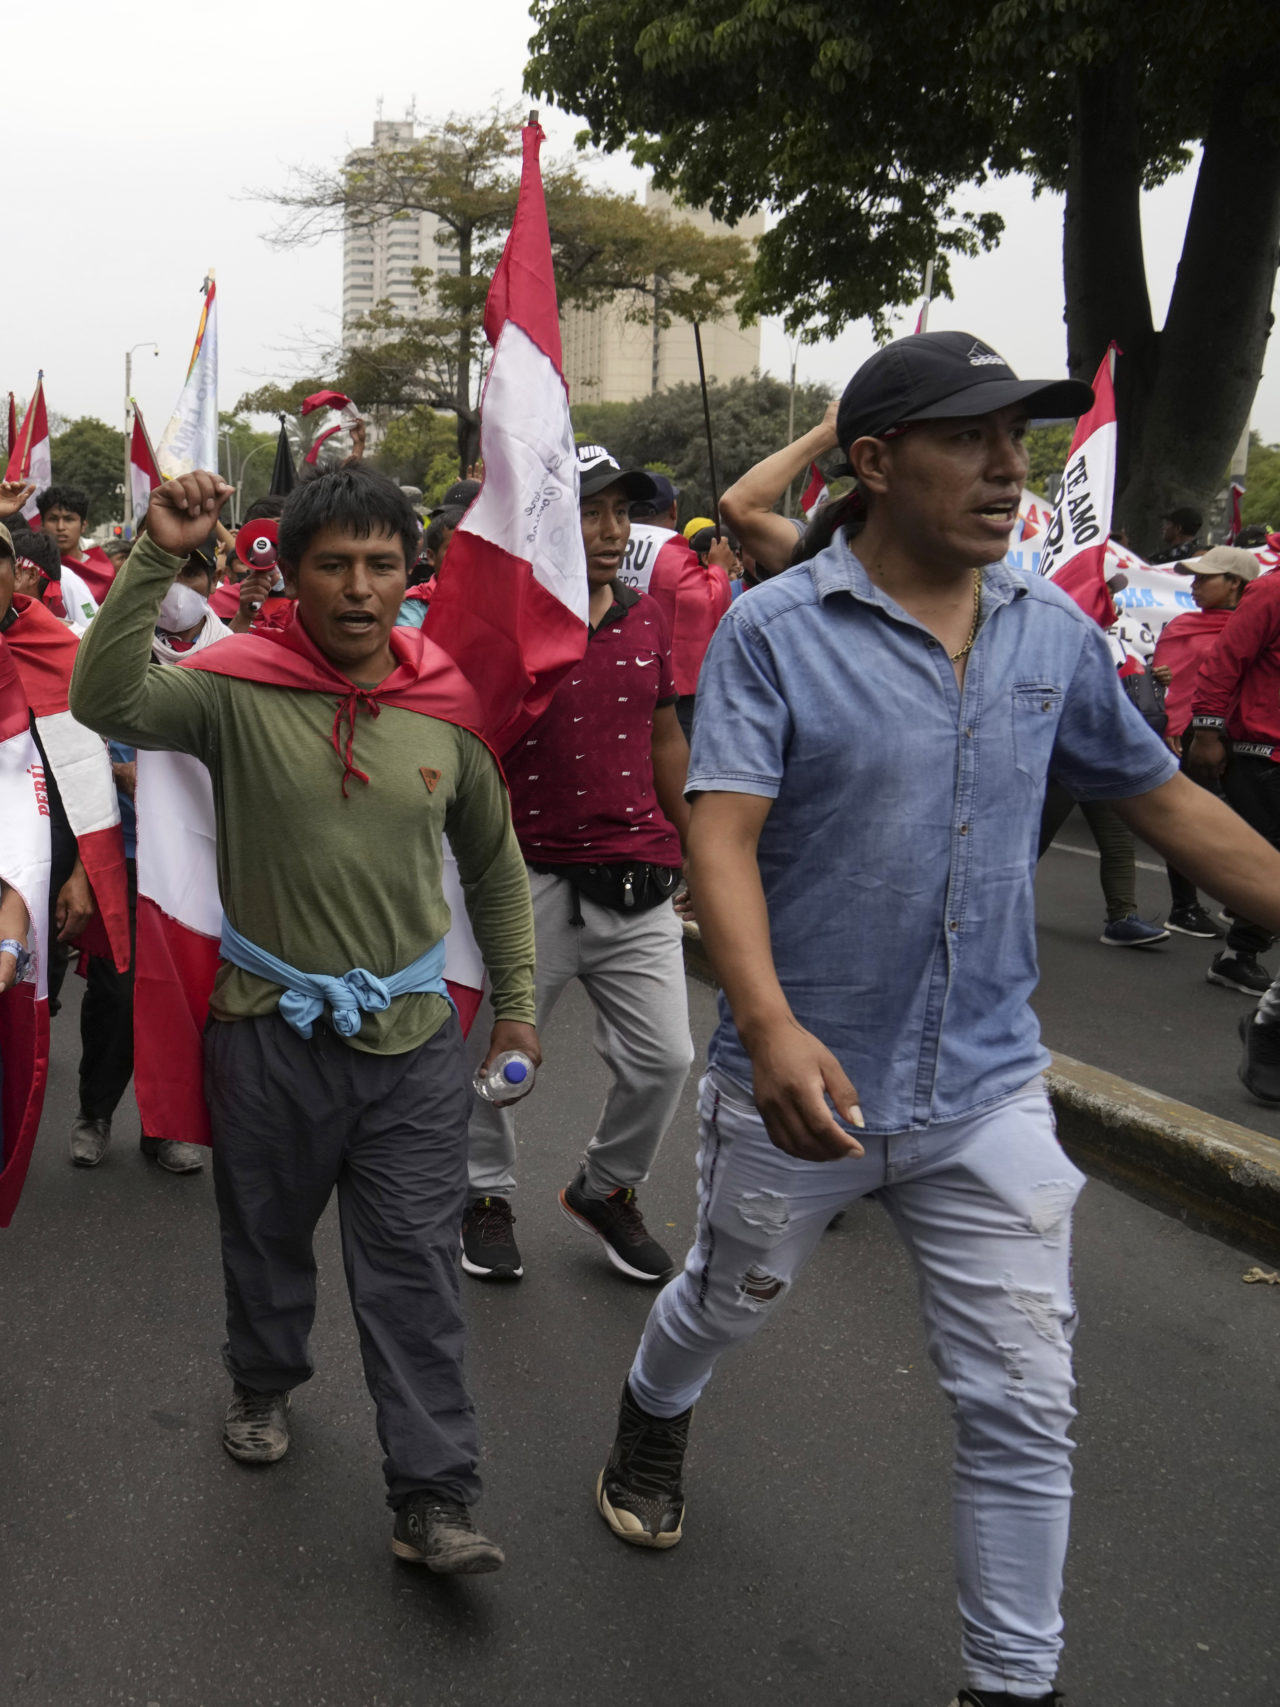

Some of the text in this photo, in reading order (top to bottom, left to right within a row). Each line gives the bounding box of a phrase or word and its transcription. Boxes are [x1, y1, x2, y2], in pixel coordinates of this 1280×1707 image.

[1066, 455, 1100, 545] TE AMO
[620, 535, 653, 571] RÚ
